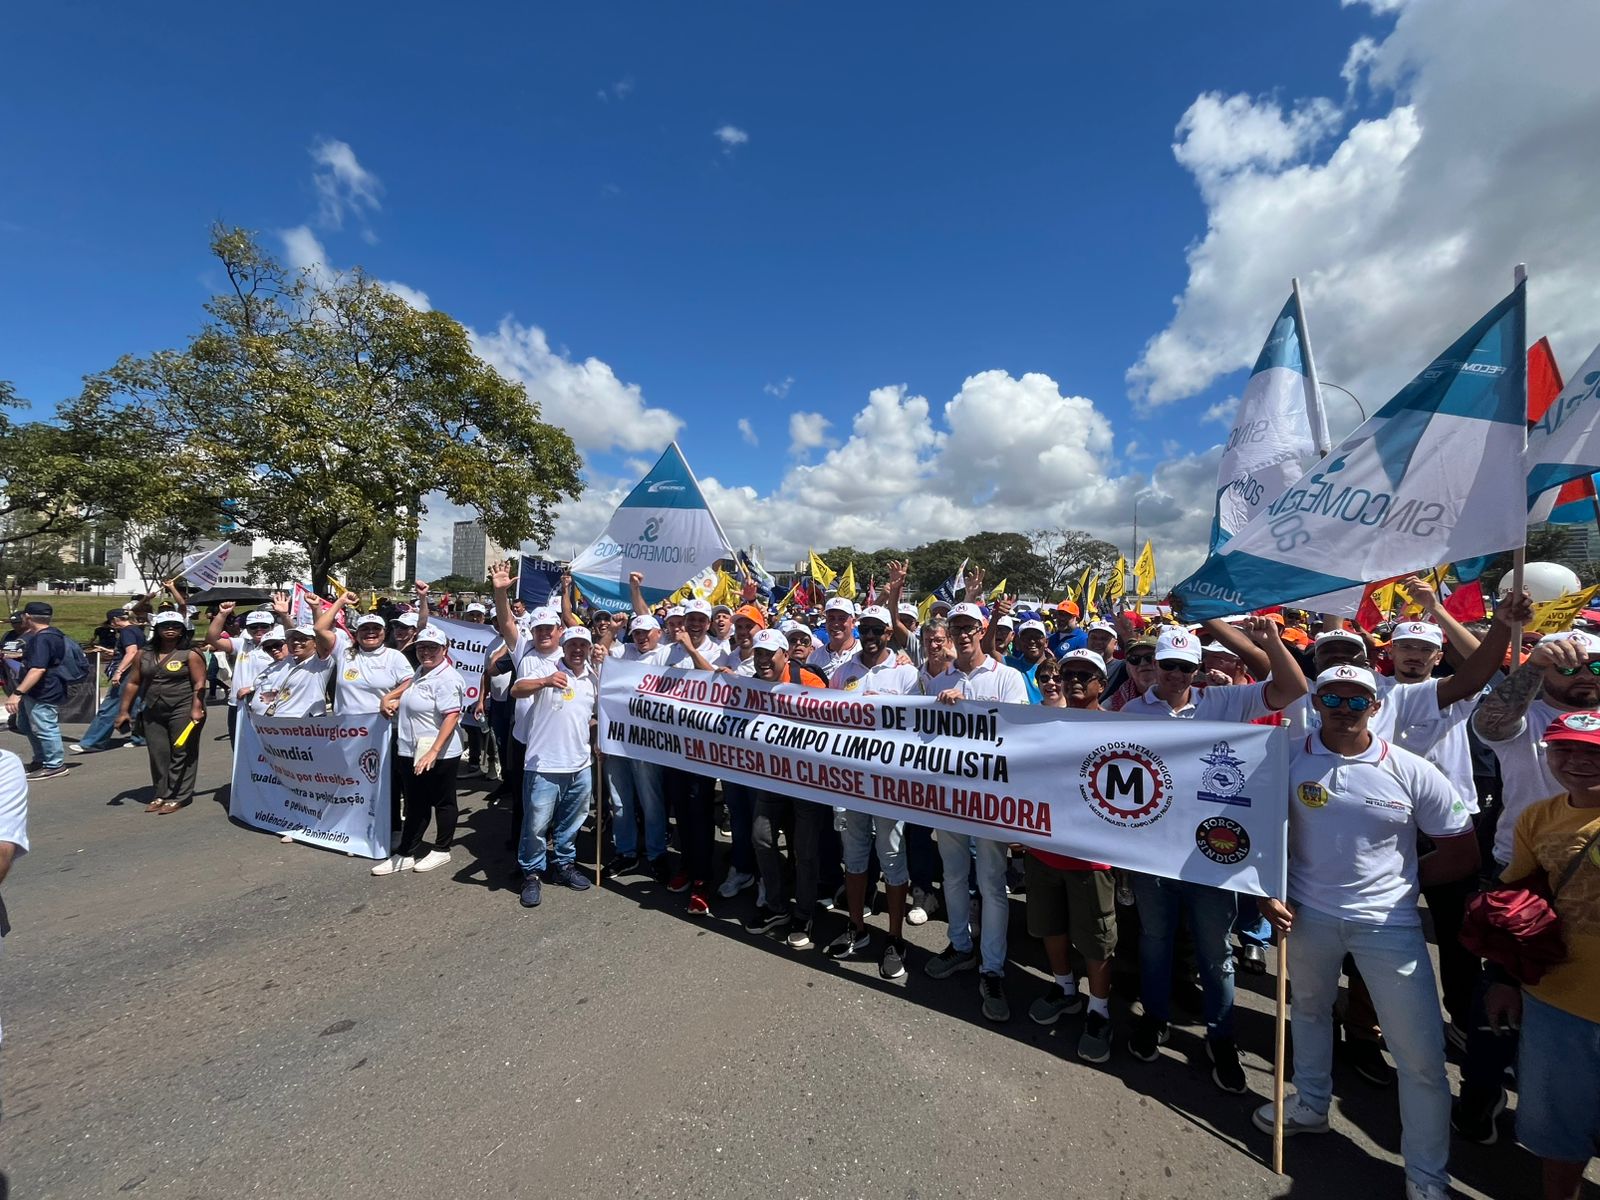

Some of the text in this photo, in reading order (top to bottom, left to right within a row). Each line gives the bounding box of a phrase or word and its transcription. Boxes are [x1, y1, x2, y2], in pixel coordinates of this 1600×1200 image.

[279, 723, 369, 741] metalúrgicos
[638, 674, 1004, 747] SINDICATO DOS METALÚRGICOS DE JUNDIAÍ,
[628, 694, 1009, 783] VÁRZEA PAULISTA E CAMPO LIMPO PAULISTA
[607, 721, 1051, 832] NA MARCHA EM DEFESA DA CLASSE TRABALHADORA
[1080, 745, 1107, 778] SINDICATO
[1107, 742, 1126, 750] DOS
[1127, 742, 1173, 790] METALÚRGICOS
[1106, 764, 1144, 805] M
[1198, 839, 1249, 863] SINDICAL
